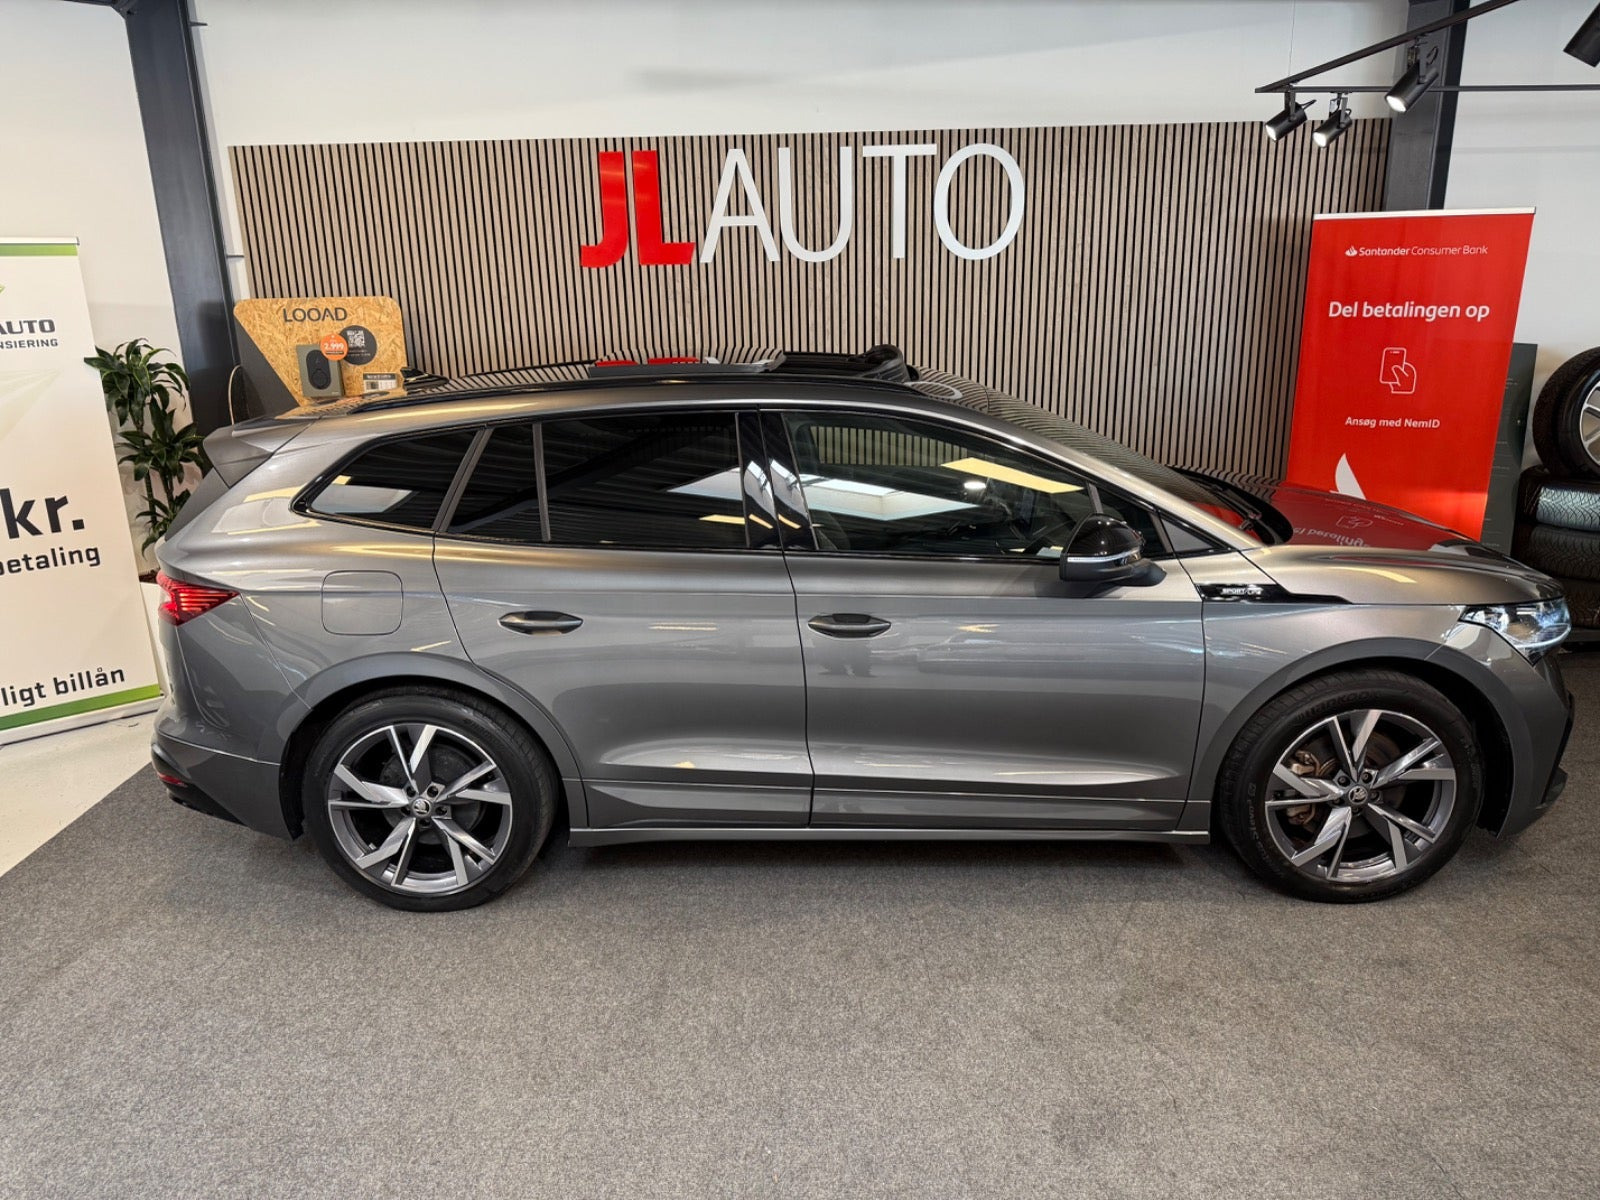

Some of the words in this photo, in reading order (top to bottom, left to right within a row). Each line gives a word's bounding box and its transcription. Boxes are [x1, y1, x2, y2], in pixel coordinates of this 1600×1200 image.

[1358, 246, 1409, 257] Santander
[1411, 246, 1461, 256] Consumer
[1462, 245, 1488, 255] Bank
[1328, 301, 1358, 318] Del
[1362, 301, 1461, 322] betalingen
[1464, 304, 1490, 322] op
[1345, 416, 1377, 428] Ansøg
[1379, 418, 1401, 427] med
[1404, 418, 1440, 428] NemID
[0, 488, 85, 540] kr.
[53, 667, 125, 696] billån
